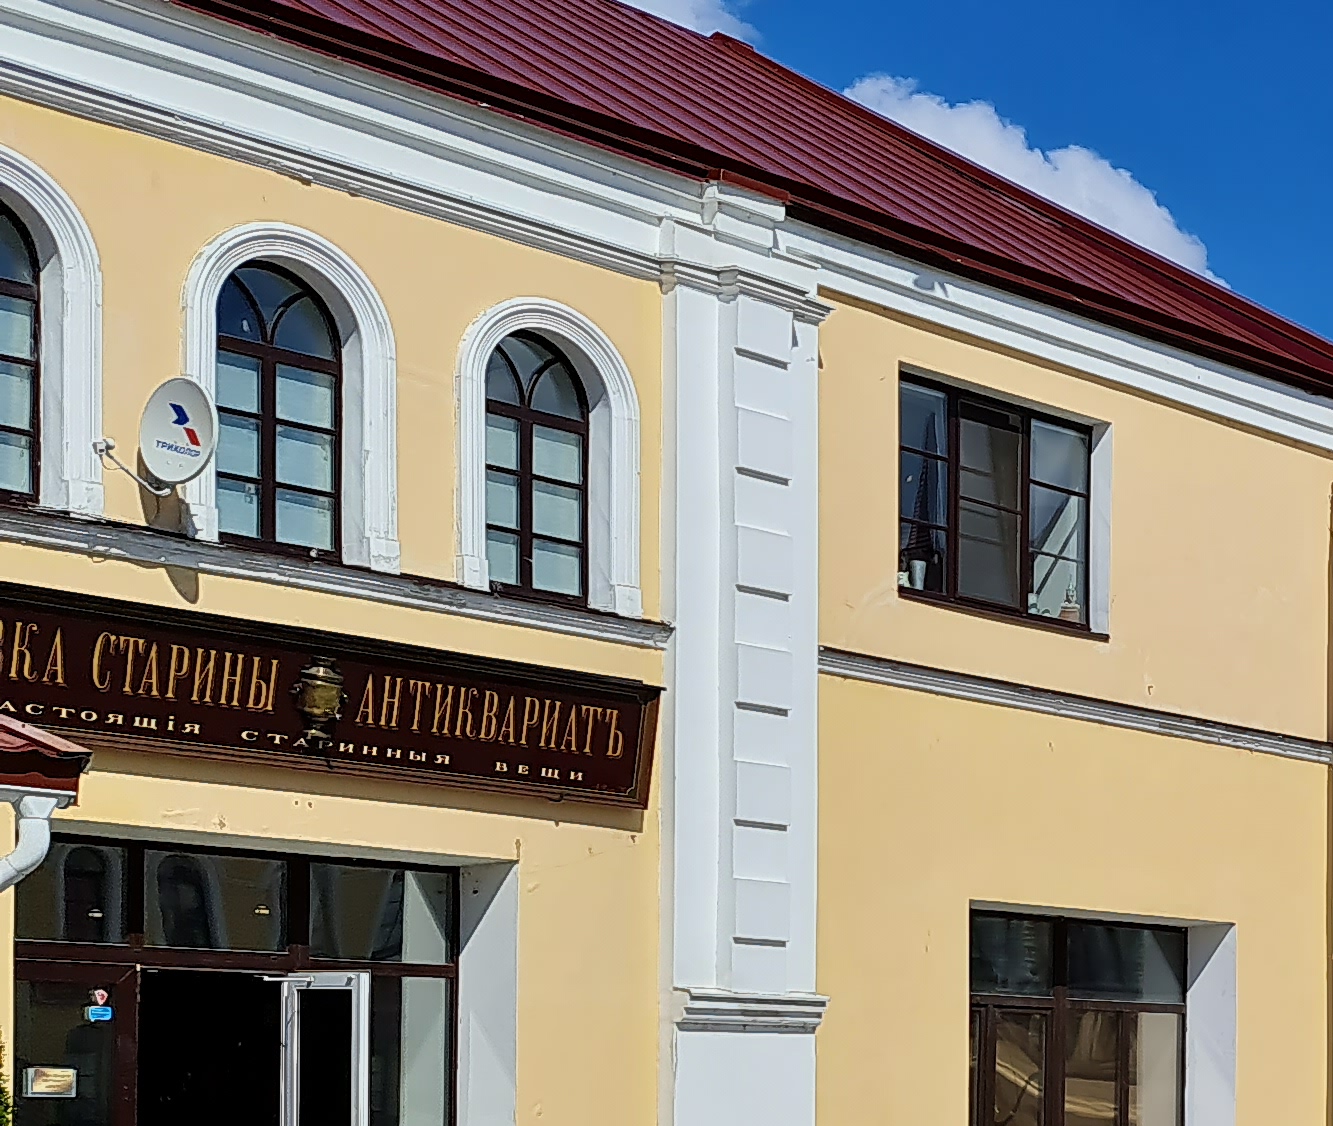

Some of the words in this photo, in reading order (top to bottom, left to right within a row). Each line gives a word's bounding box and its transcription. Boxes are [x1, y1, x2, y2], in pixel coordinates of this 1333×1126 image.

[156, 440, 200, 457] ТРИКОЛОР
[0, 619, 68, 688] КА
[92, 631, 279, 714] СТАРИНЫ
[355, 674, 624, 759] АНТИКВАРИАТЪ
[240, 730, 451, 765] СТАРИННЫЯ
[494, 761, 584, 781] ВЕЩИ
